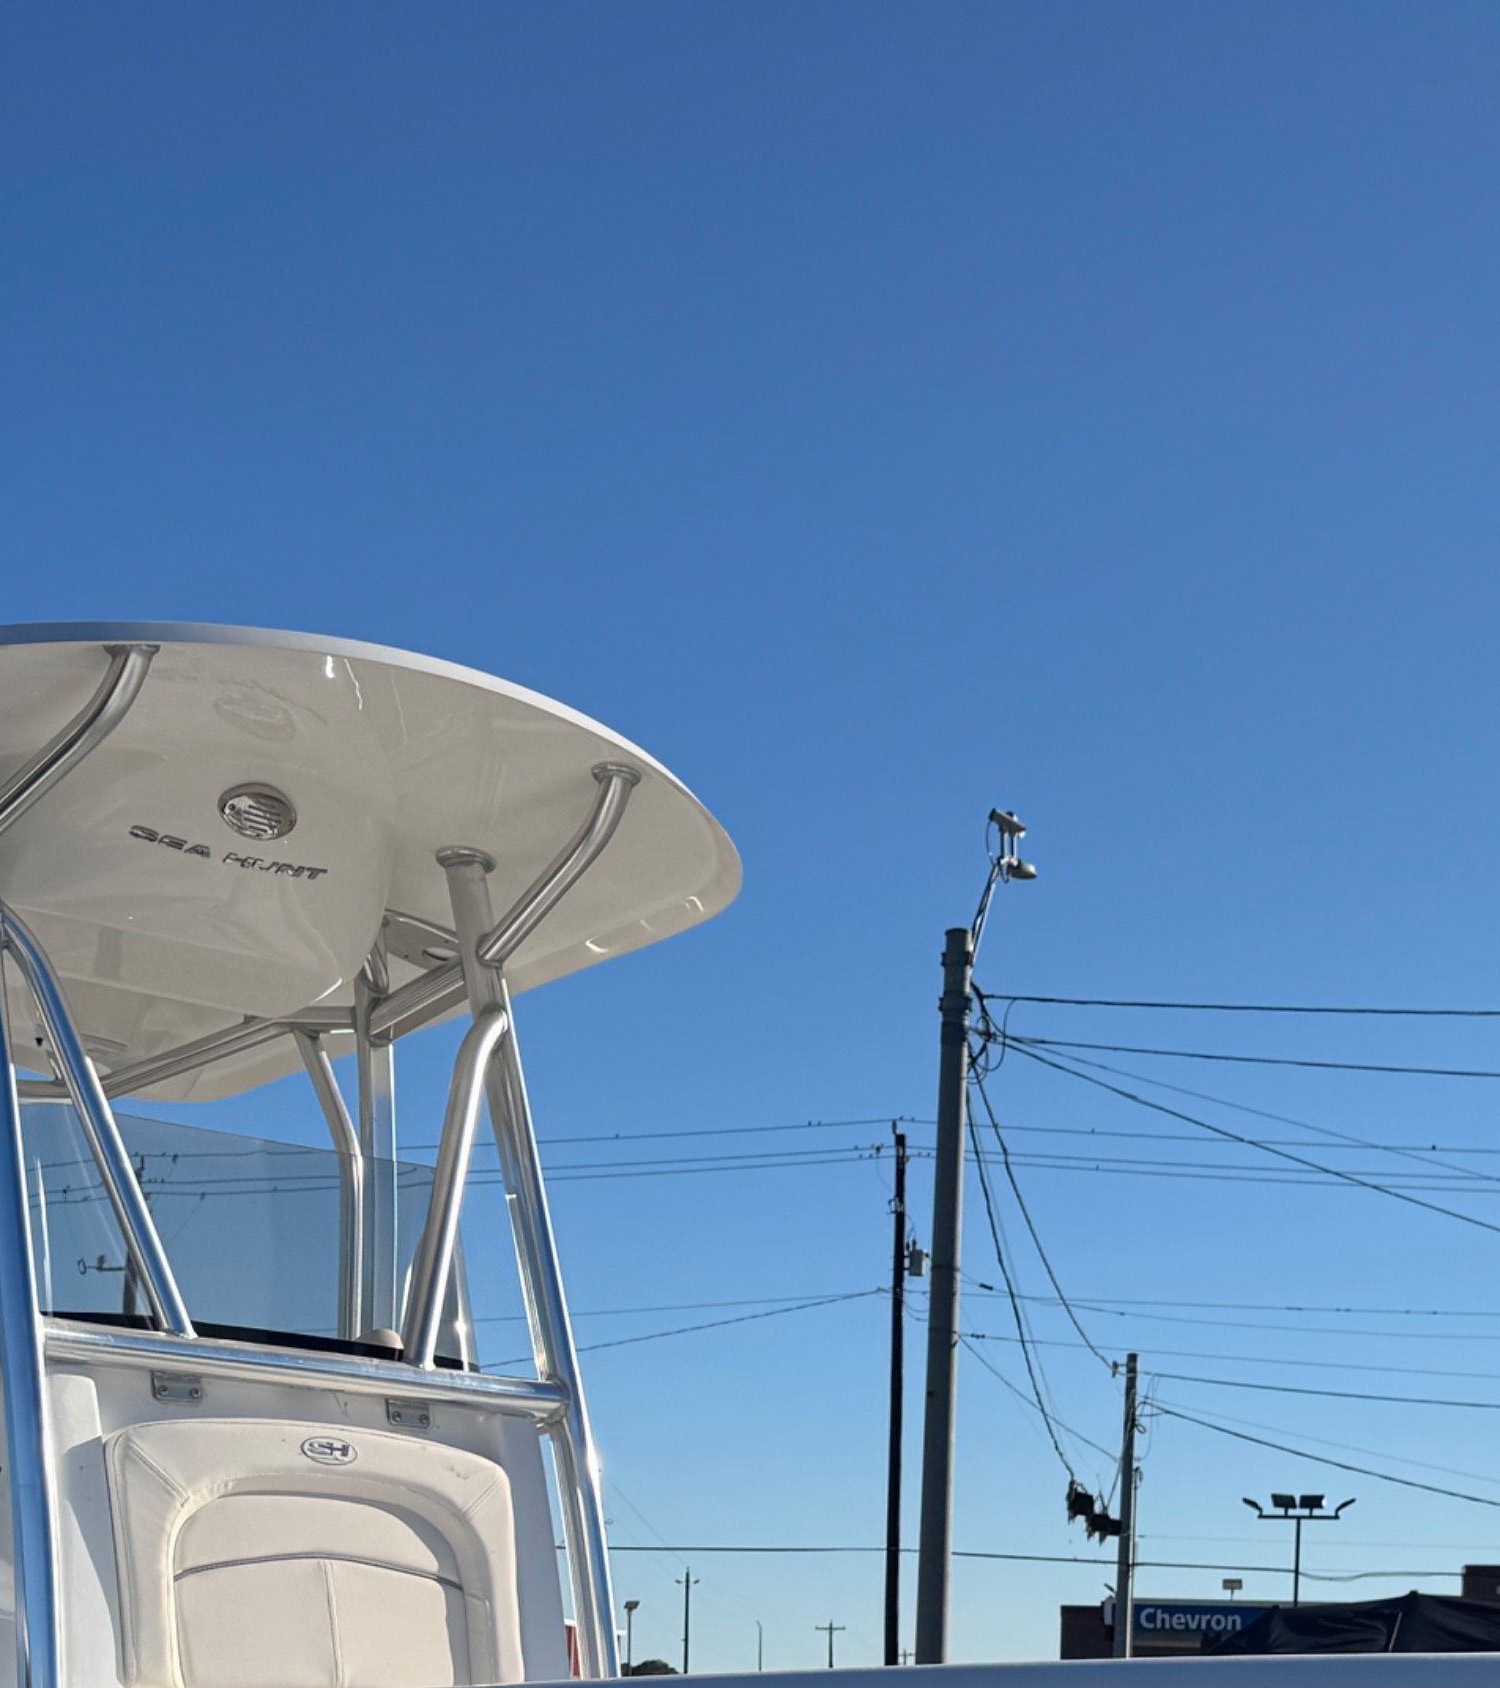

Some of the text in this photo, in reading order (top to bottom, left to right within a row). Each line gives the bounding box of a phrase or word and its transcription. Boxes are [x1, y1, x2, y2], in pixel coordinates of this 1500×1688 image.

[128, 824, 329, 880] SEA HUNT
[1139, 1607, 1243, 1632] Chevron
